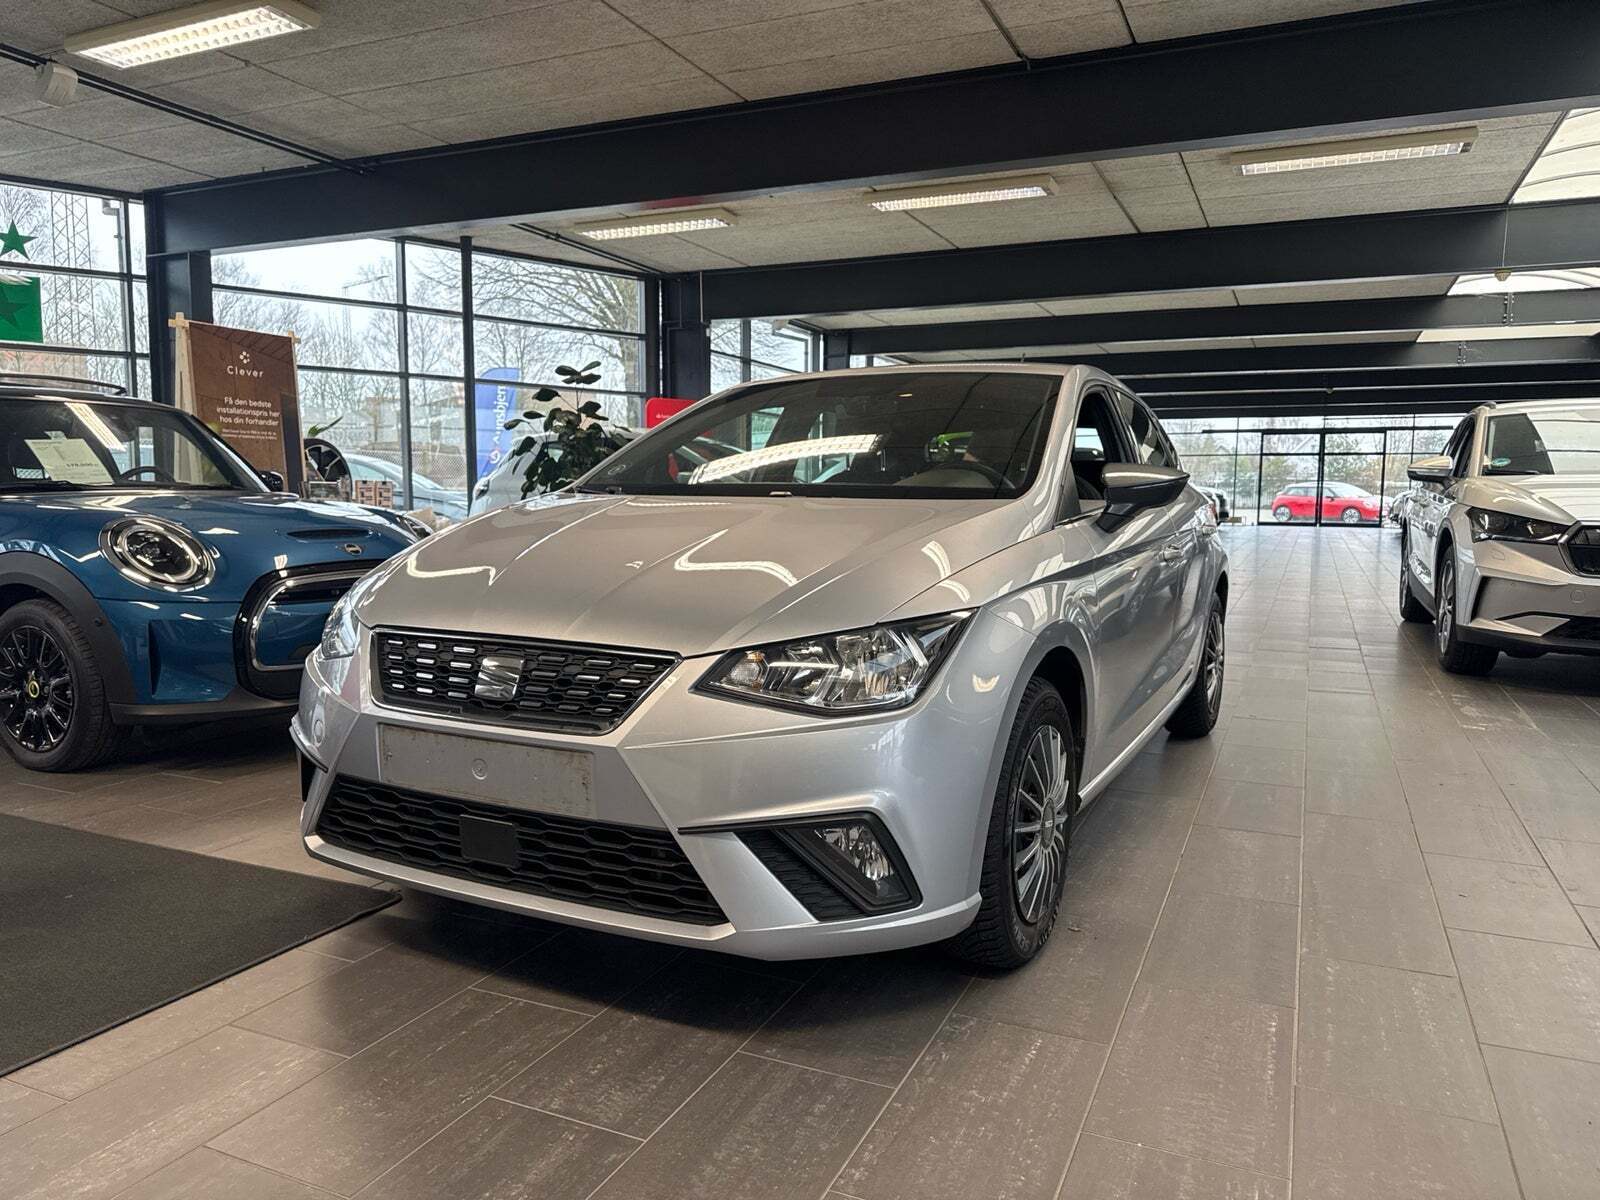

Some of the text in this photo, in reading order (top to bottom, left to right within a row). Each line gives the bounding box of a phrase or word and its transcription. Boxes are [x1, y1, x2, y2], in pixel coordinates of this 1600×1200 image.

[227, 365, 264, 378] Clever
[224, 396, 272, 408] Få den bedste
[216, 406, 268, 417] installationspris
[220, 415, 280, 426] hos din forhandler
